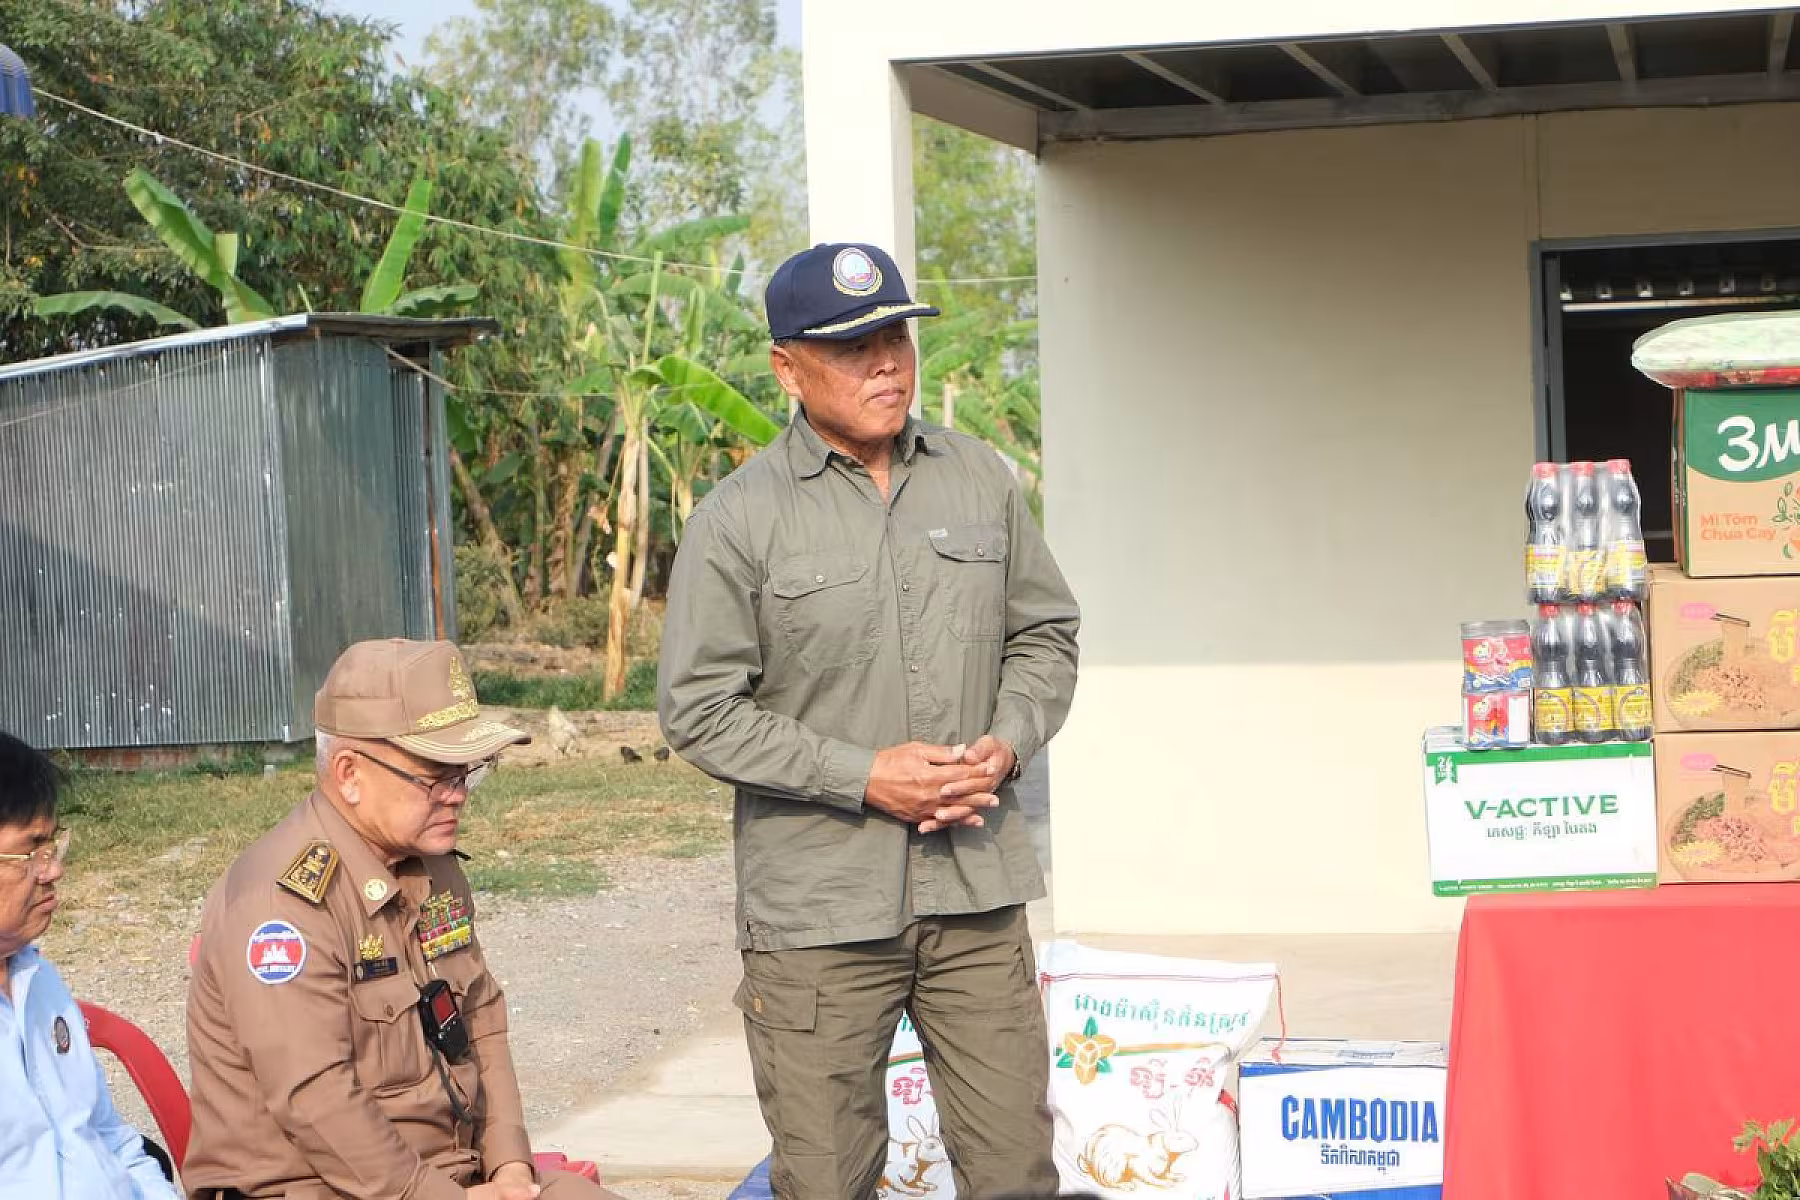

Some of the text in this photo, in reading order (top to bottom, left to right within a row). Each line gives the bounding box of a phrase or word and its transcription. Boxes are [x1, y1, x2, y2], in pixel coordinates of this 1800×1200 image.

[1701, 527, 1776, 541] Chua Cay
[1464, 795, 1618, 819] V-ACTIVE
[1281, 1095, 1439, 1143] CAMBODIA
